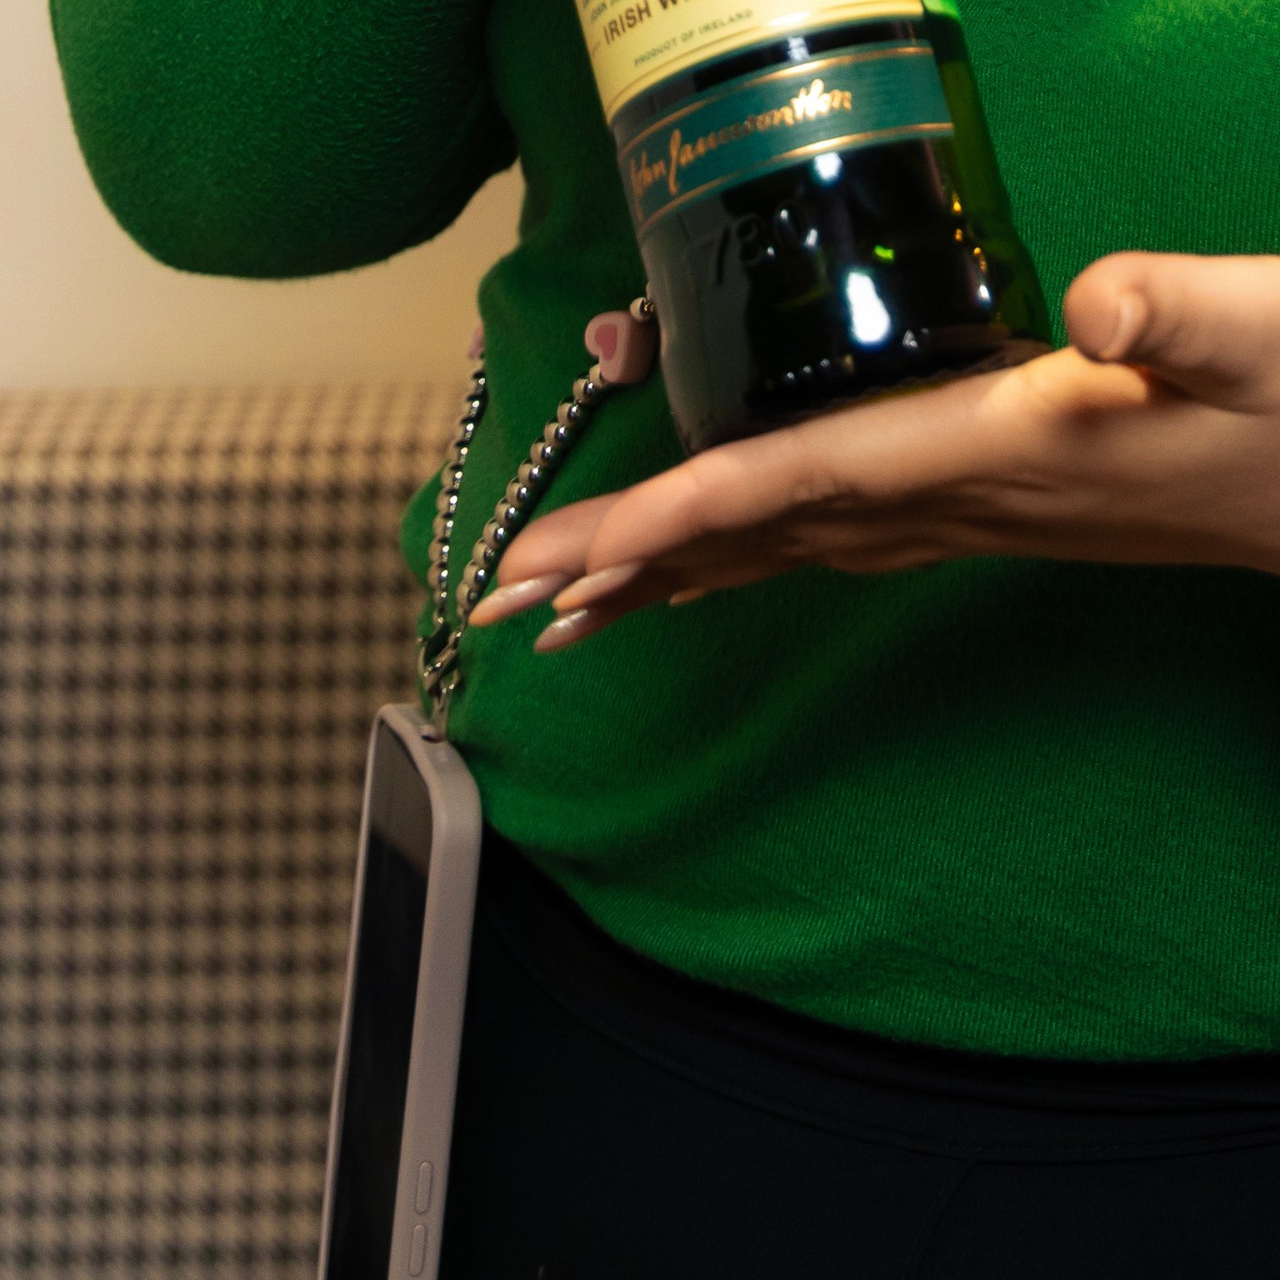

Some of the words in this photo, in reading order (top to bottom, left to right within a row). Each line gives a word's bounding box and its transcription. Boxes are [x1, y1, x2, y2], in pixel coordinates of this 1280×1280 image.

[603, 0, 652, 45] IRISH
[634, 37, 678, 66] PRODUCT
[680, 29, 695, 42] OF
[698, 8, 753, 34] IRELAND
